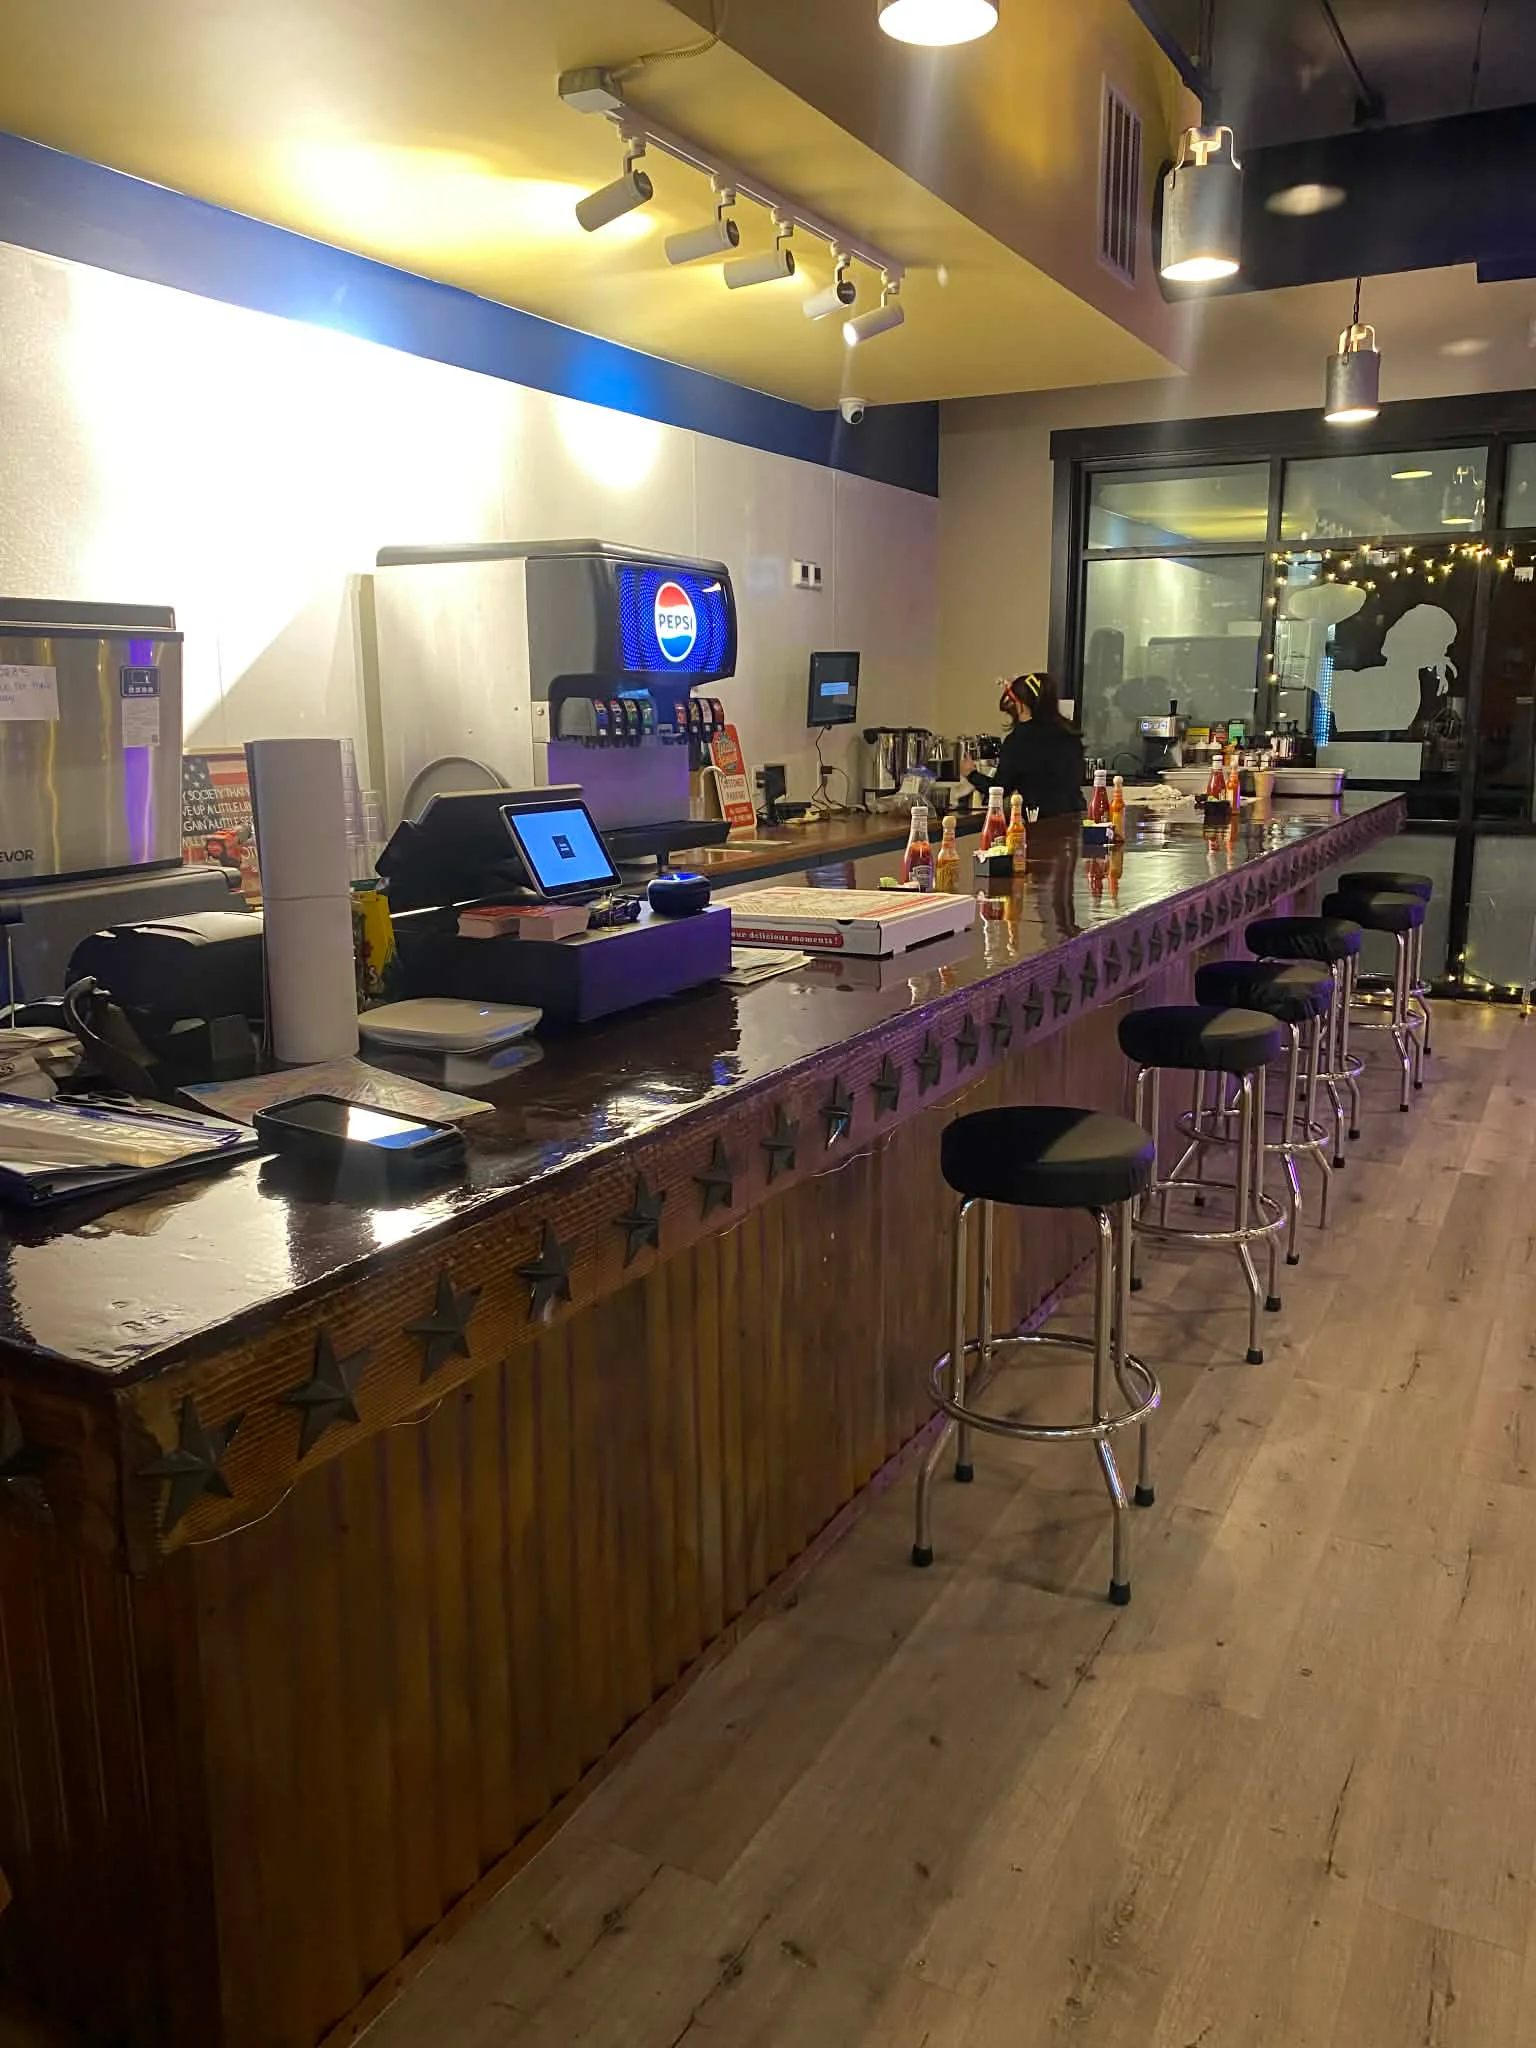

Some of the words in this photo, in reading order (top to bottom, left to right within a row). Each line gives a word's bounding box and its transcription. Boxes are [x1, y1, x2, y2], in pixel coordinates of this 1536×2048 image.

[658, 614, 693, 630] PEPSI
[183, 818, 208, 832] GAIN
[749, 930, 789, 942] delicious
